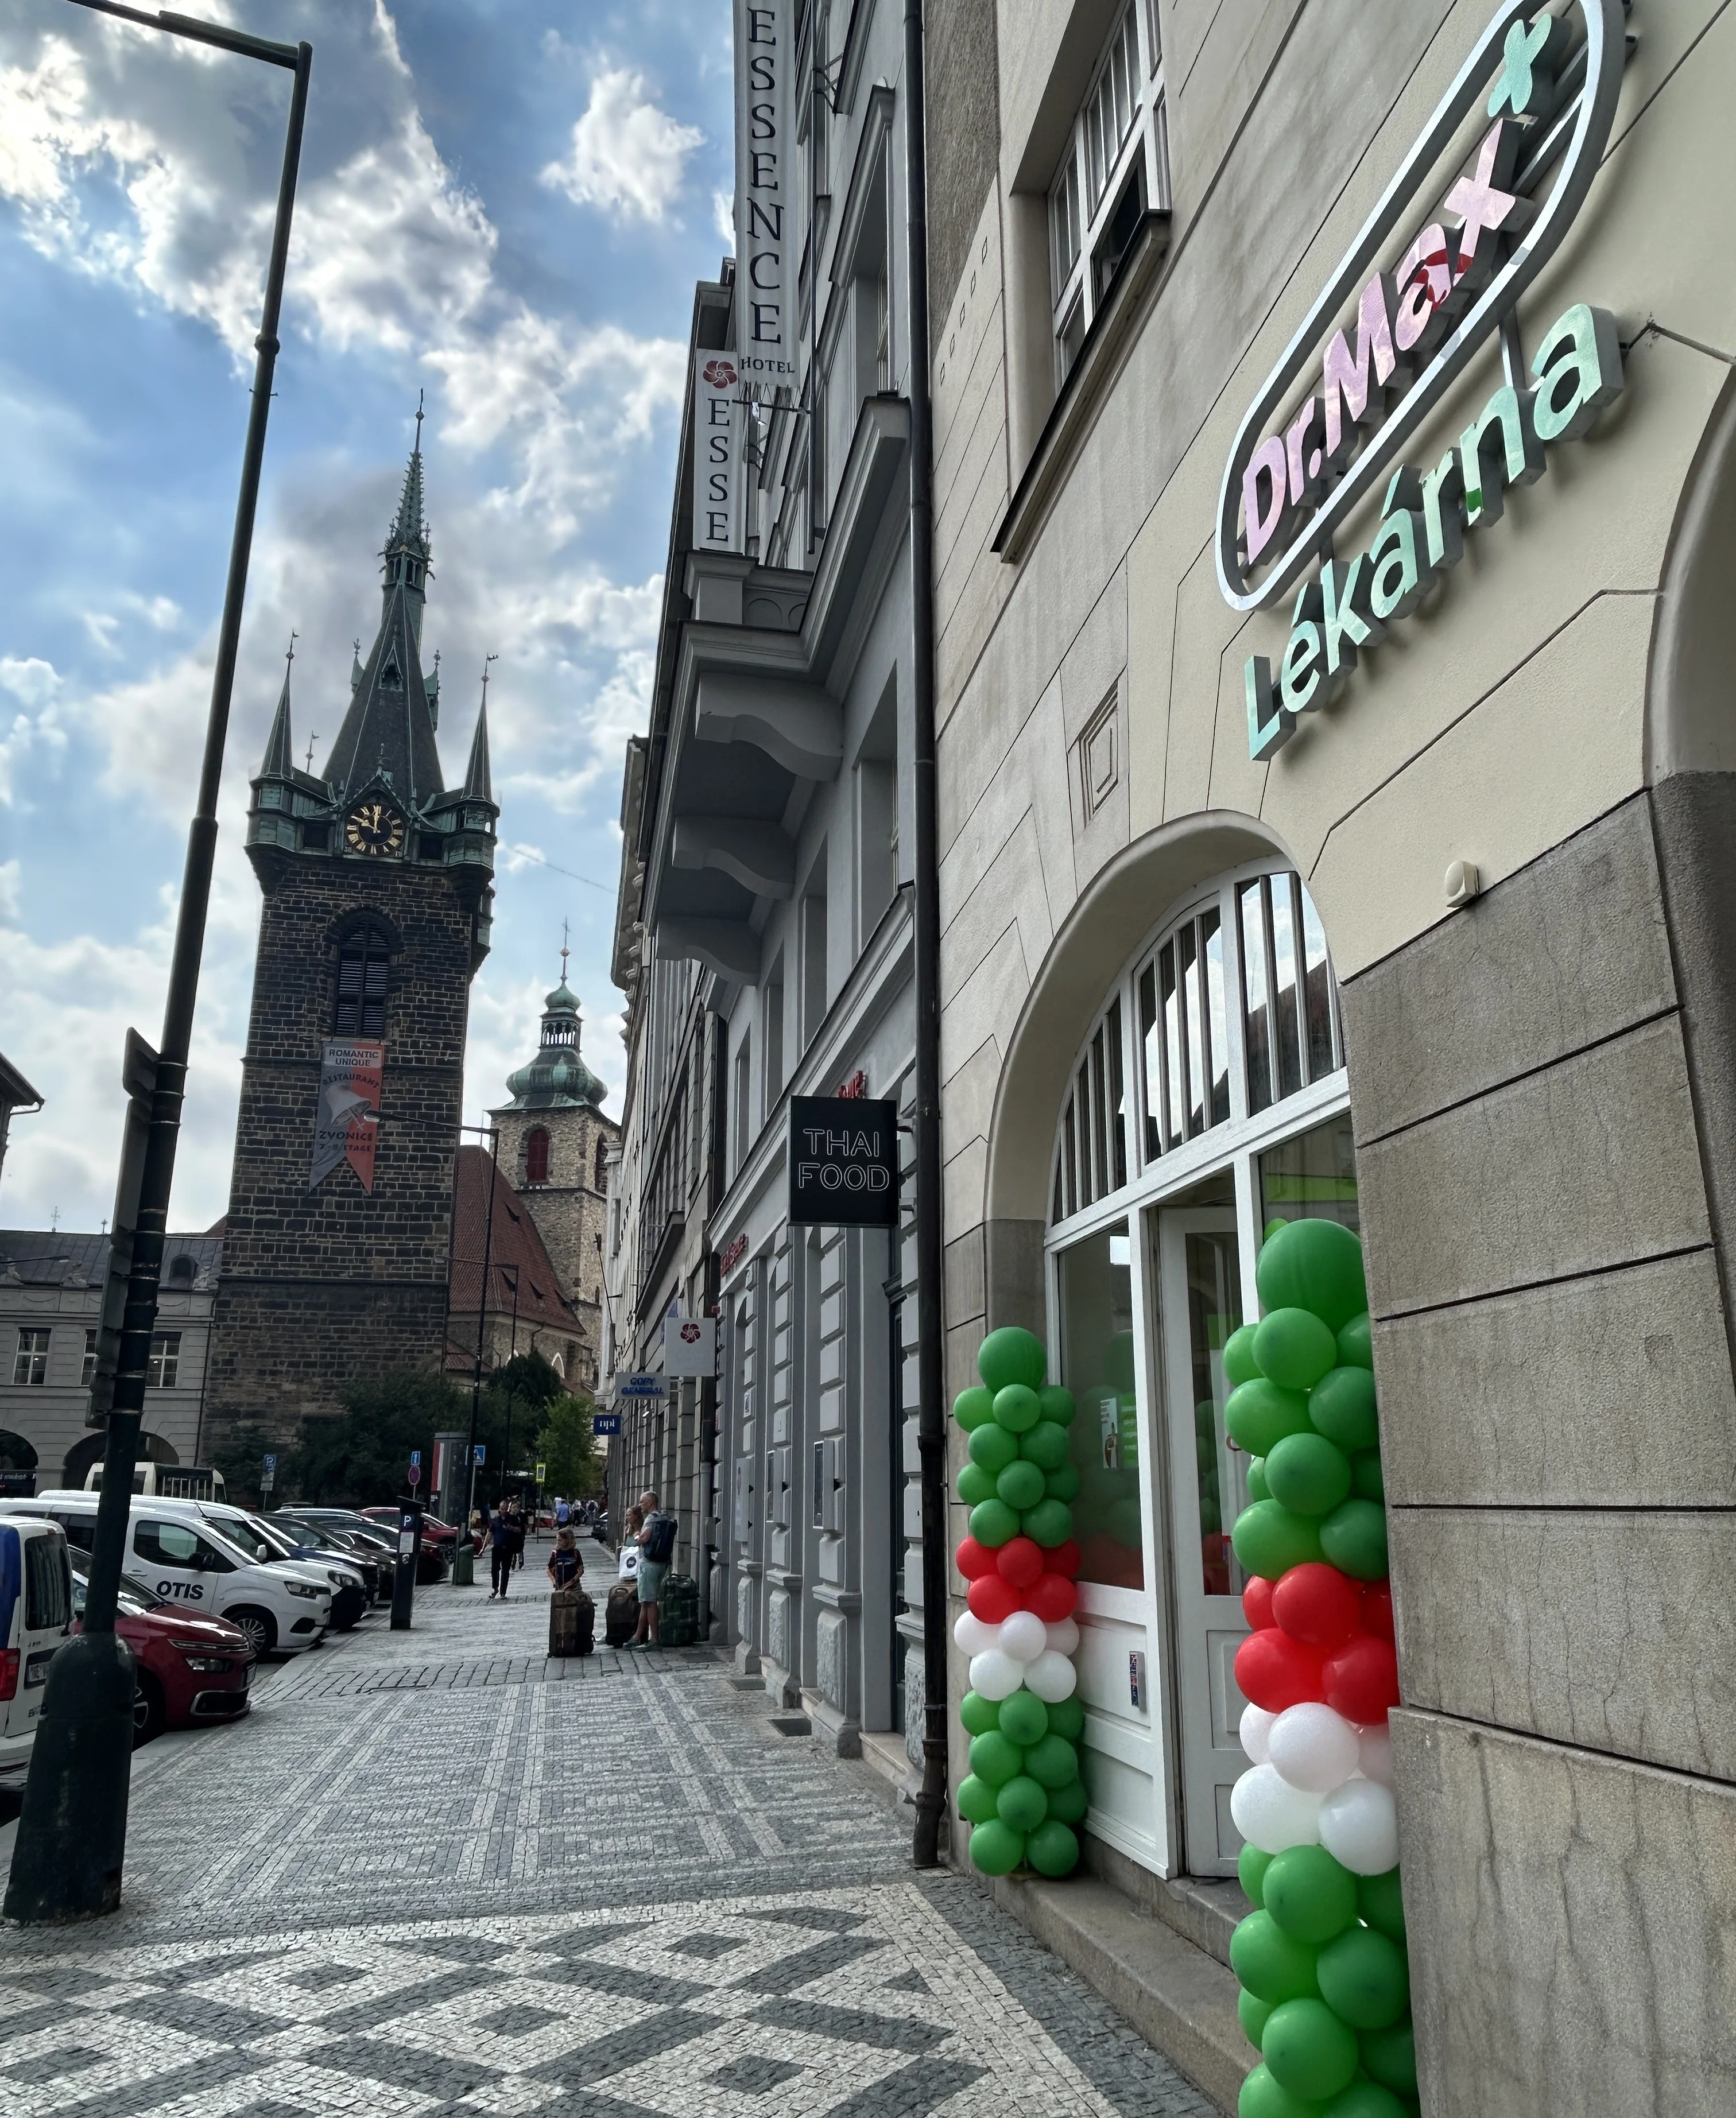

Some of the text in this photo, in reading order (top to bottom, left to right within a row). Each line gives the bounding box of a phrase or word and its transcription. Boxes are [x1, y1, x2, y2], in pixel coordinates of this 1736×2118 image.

[747, 7, 785, 344] ESSENCE
[1242, 118, 1517, 565] Dr.Max
[740, 356, 795, 373] HOTEL
[706, 398, 730, 542] ESSE
[1243, 302, 1603, 761] Lékárna
[329, 1049, 379, 1058] ROMANTIC
[335, 1058, 371, 1066] UNIQUE
[323, 1072, 380, 1088] RESTAURANT
[319, 1130, 374, 1142] ZVONICE
[803, 1128, 879, 1158] THAI
[799, 1162, 890, 1192] FOOD
[403, 1515, 412, 1527] P
[156, 1580, 204, 1600] OTIS
